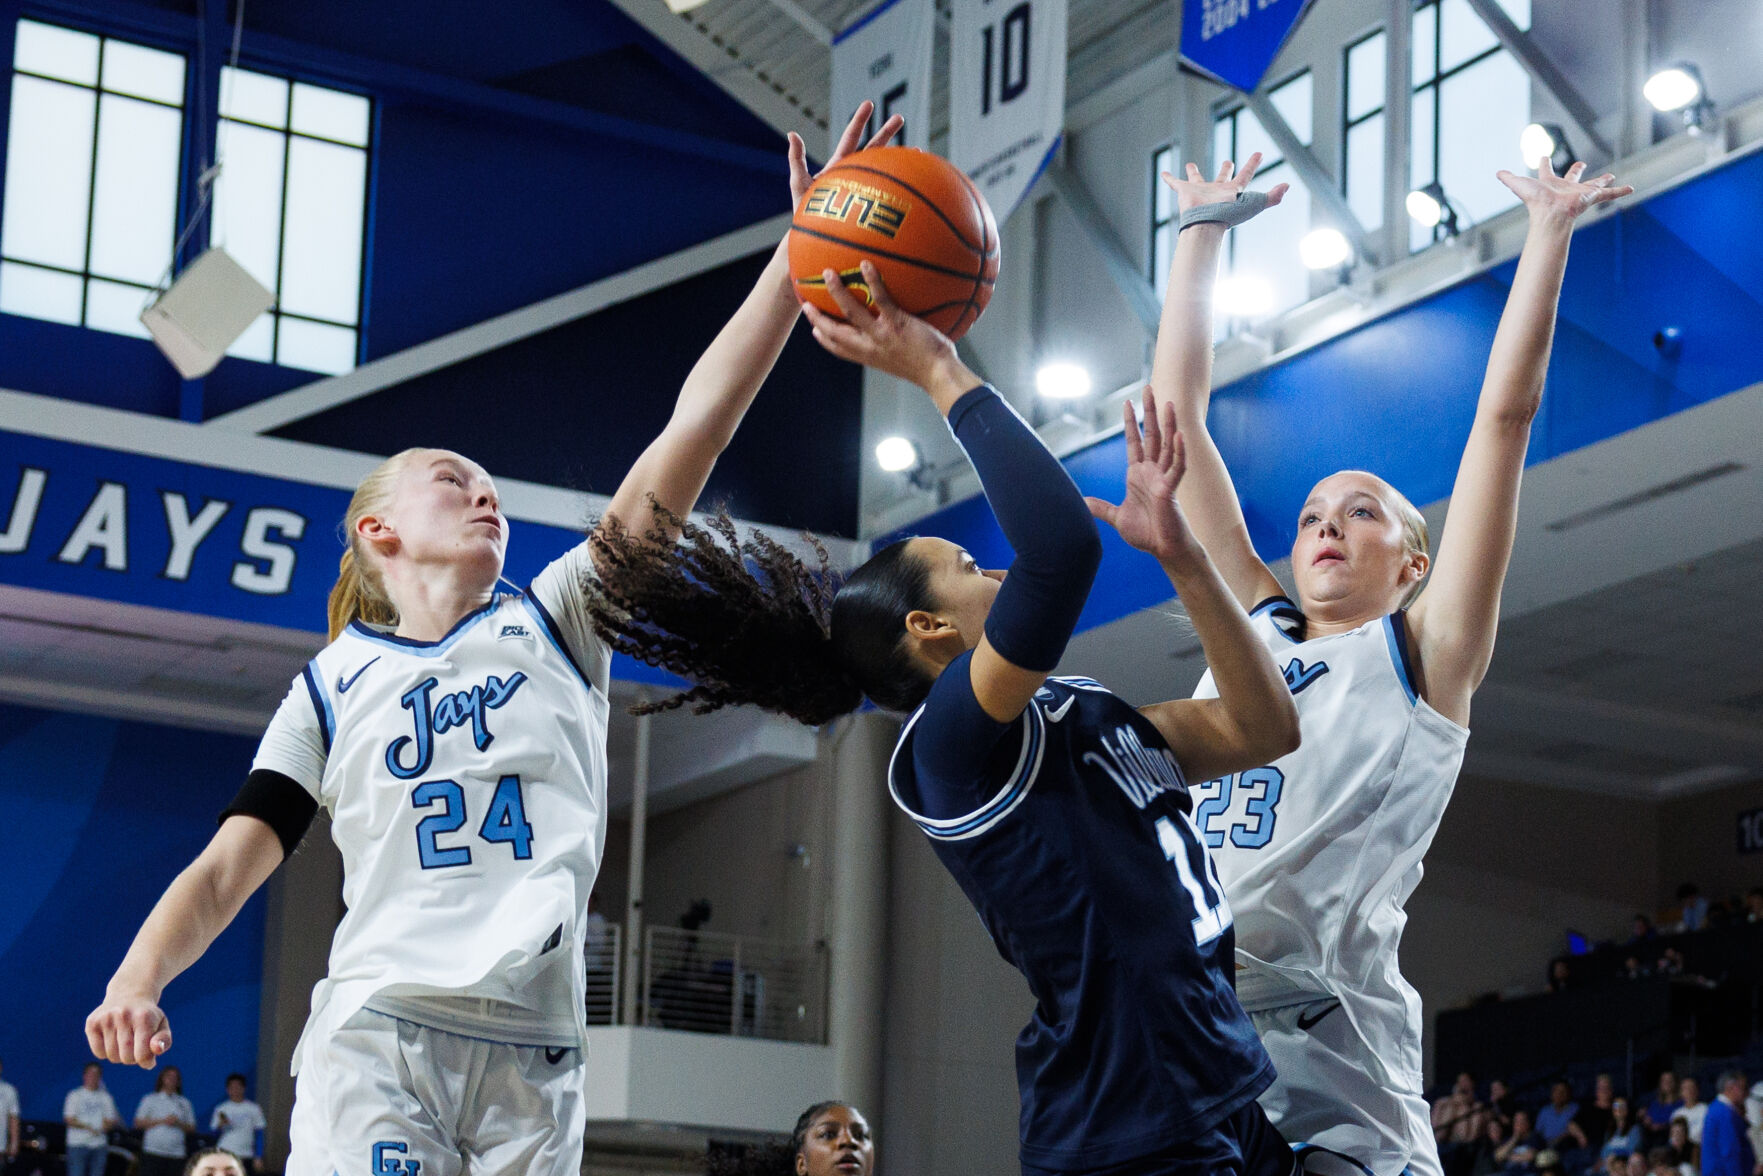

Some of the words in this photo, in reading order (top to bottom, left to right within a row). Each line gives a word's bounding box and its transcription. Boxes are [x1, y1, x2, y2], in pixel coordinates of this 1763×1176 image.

[980, 1, 1032, 116] 10
[803, 185, 907, 239] ELITE
[0, 465, 309, 596] JAYS
[385, 671, 528, 780] Jays
[411, 773, 534, 870] 24
[1194, 765, 1285, 849] 23
